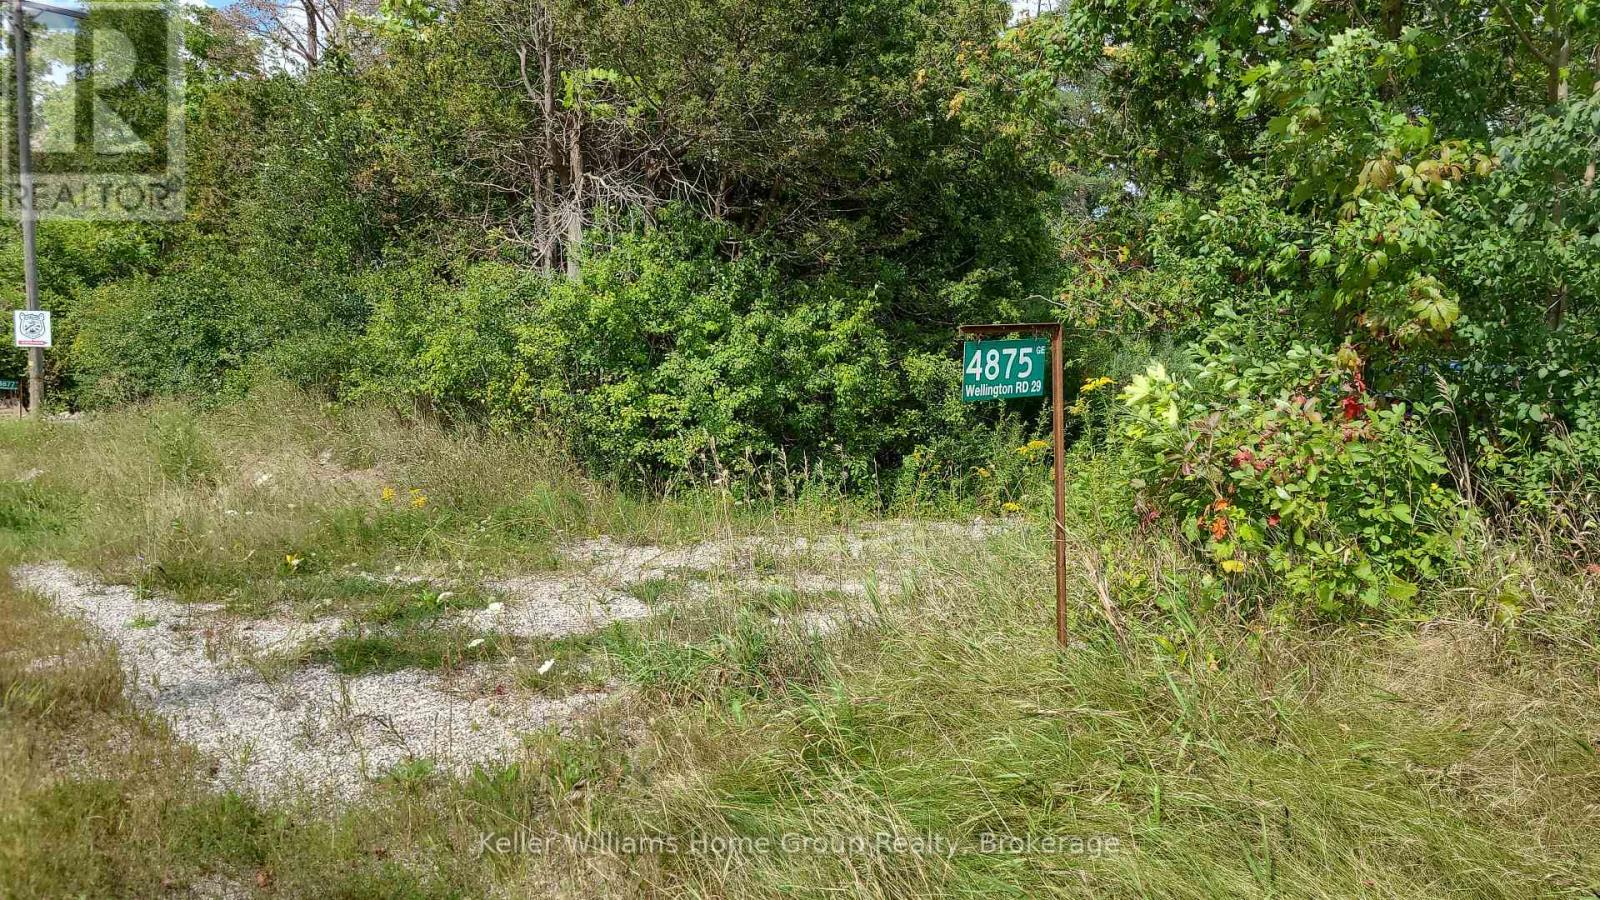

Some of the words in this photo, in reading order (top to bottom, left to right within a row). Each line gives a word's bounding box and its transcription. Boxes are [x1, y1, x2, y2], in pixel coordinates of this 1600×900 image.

[965, 347, 1033, 381] 4875
[1036, 346, 1046, 354] GE
[965, 383, 1013, 398] Wellington
[1015, 381, 1029, 394] RD
[1031, 380, 1042, 393] 29
